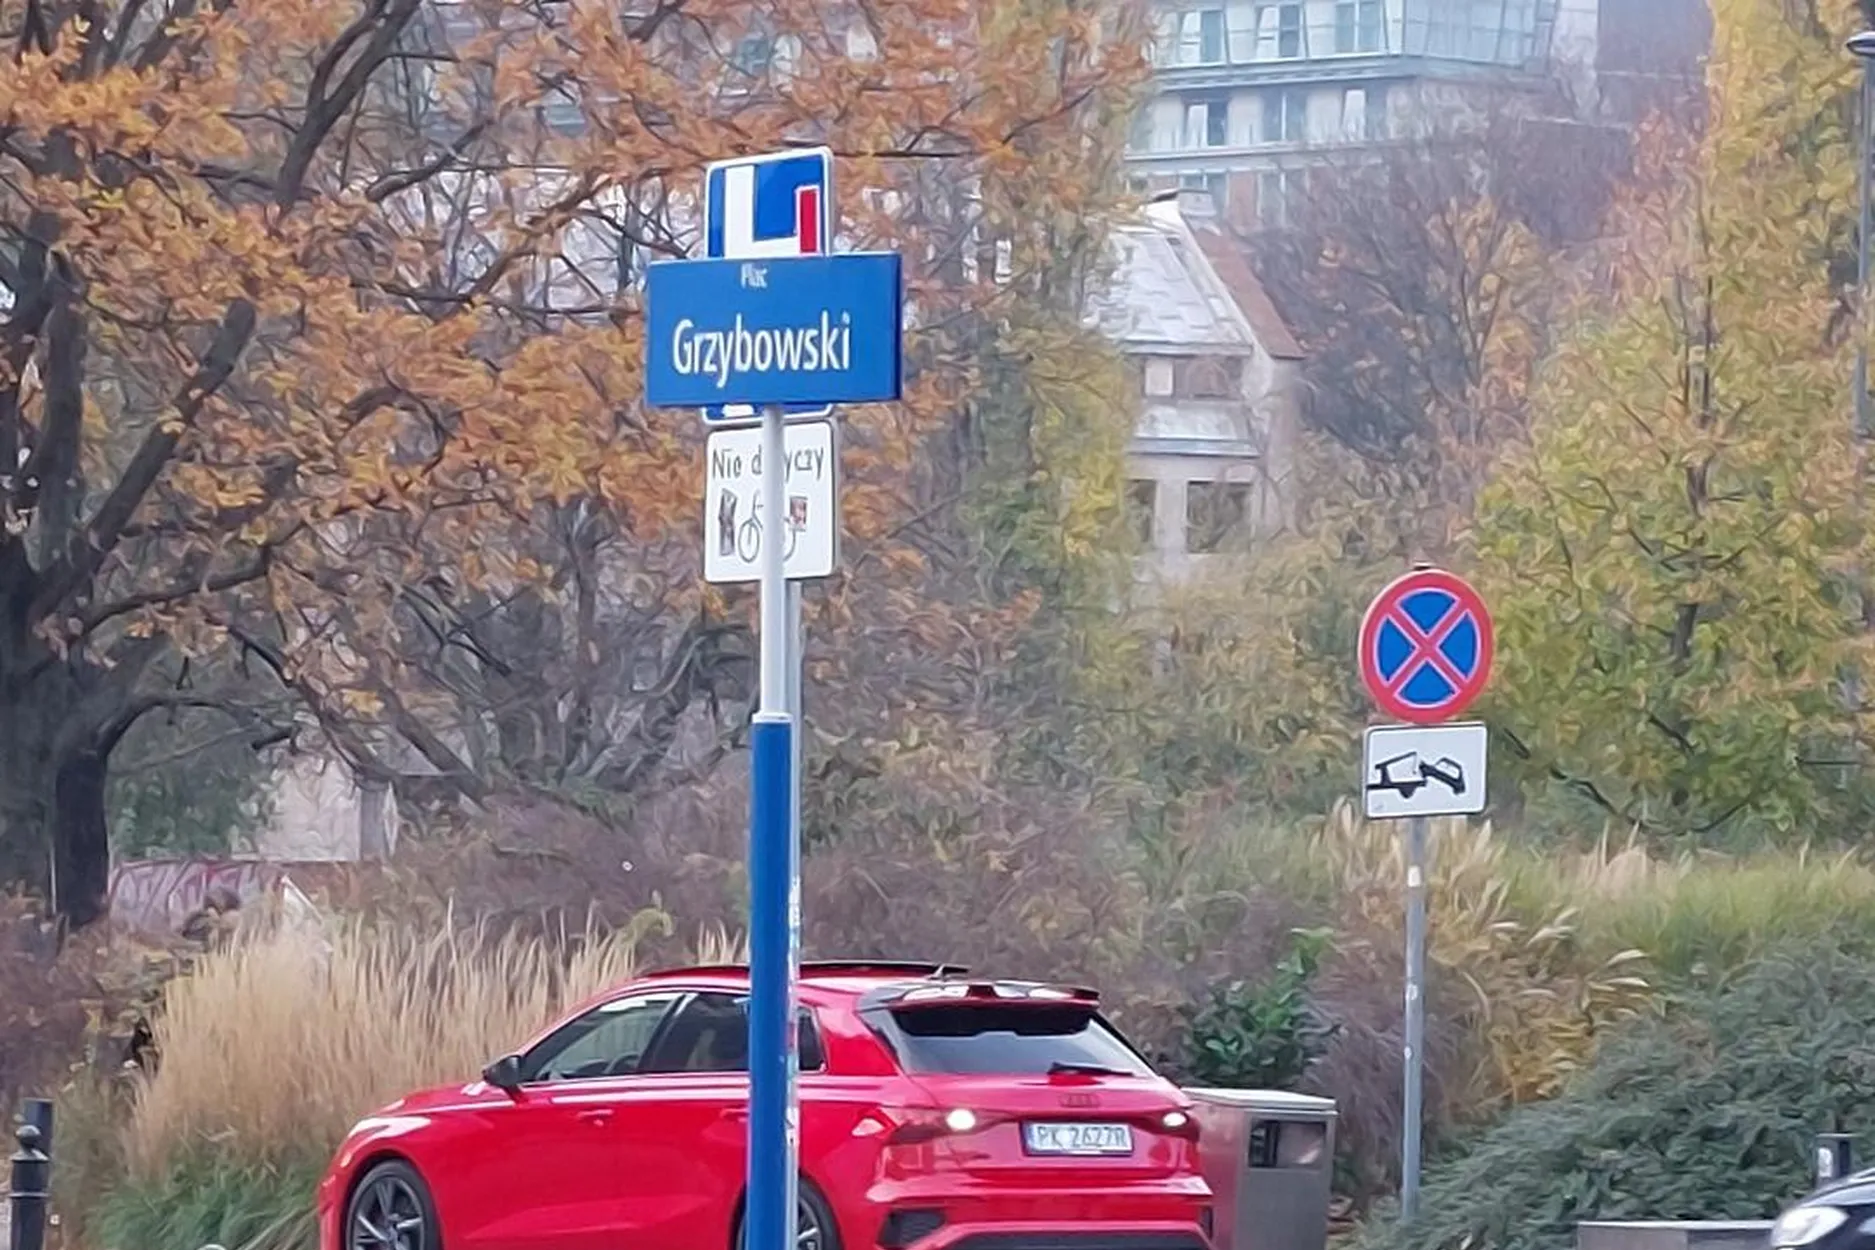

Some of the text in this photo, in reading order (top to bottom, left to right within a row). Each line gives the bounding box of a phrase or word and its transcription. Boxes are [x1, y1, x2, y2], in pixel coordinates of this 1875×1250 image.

[672, 310, 852, 389] Grzybowski
[712, 444, 824, 483] Nie dyczy
